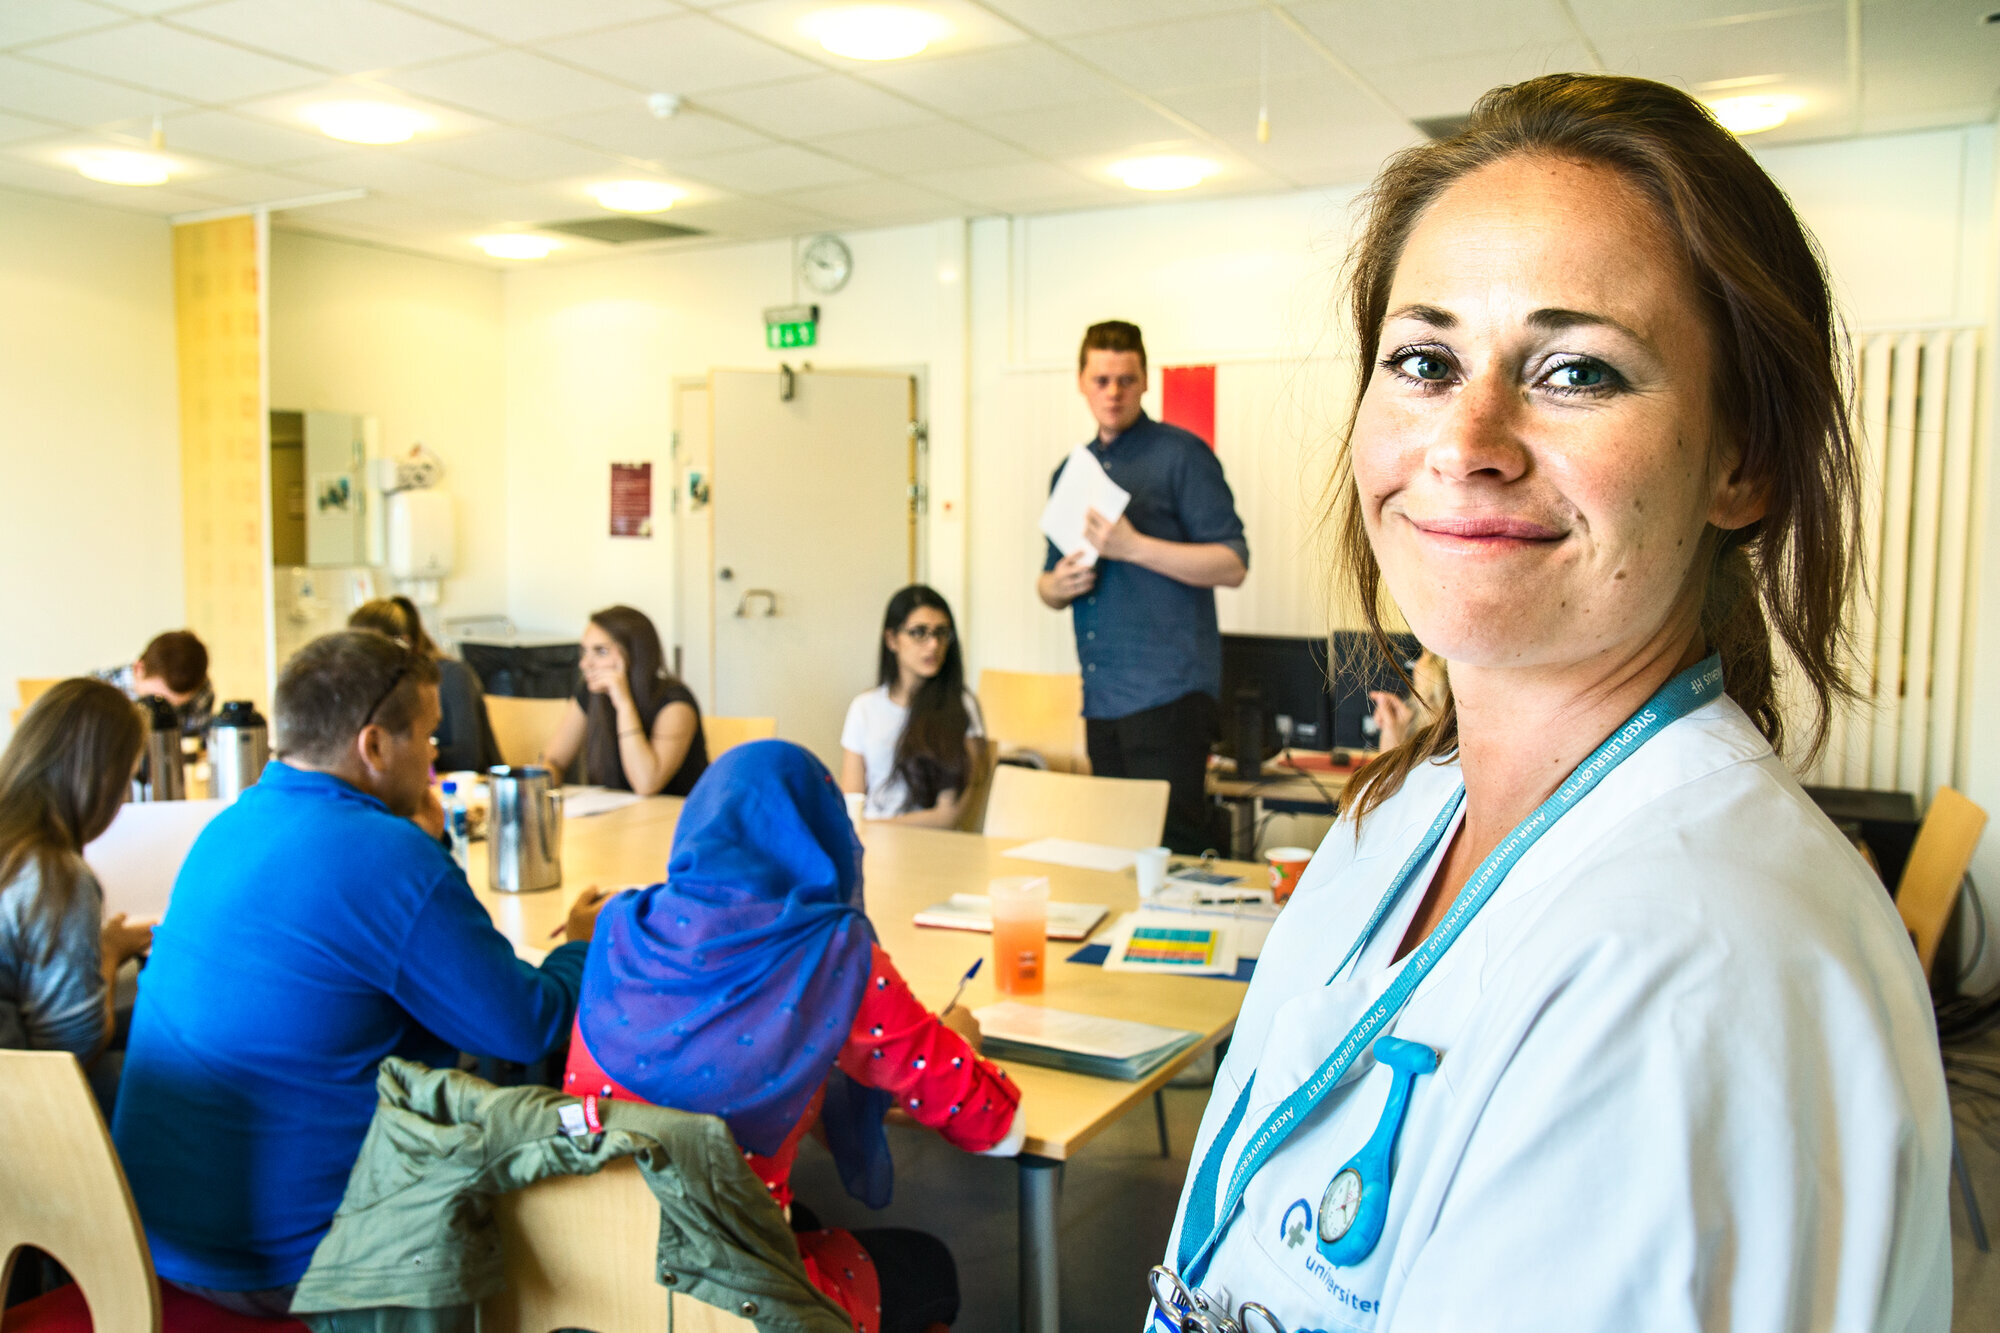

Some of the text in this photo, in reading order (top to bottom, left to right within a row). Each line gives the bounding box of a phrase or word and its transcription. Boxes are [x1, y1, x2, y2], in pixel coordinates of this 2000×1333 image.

[1690, 678, 1705, 694] HF
[1559, 709, 1657, 803] SYKEPLEIERLØFTET
[1517, 811, 1546, 839] AKER
[1429, 838, 1520, 952] UNIVERSITETSSYKEHUS
[1416, 953, 1430, 972] HF
[1306, 1004, 1387, 1101] SYKEPLEIERLØFTET
[1269, 1106, 1295, 1134] AKER
